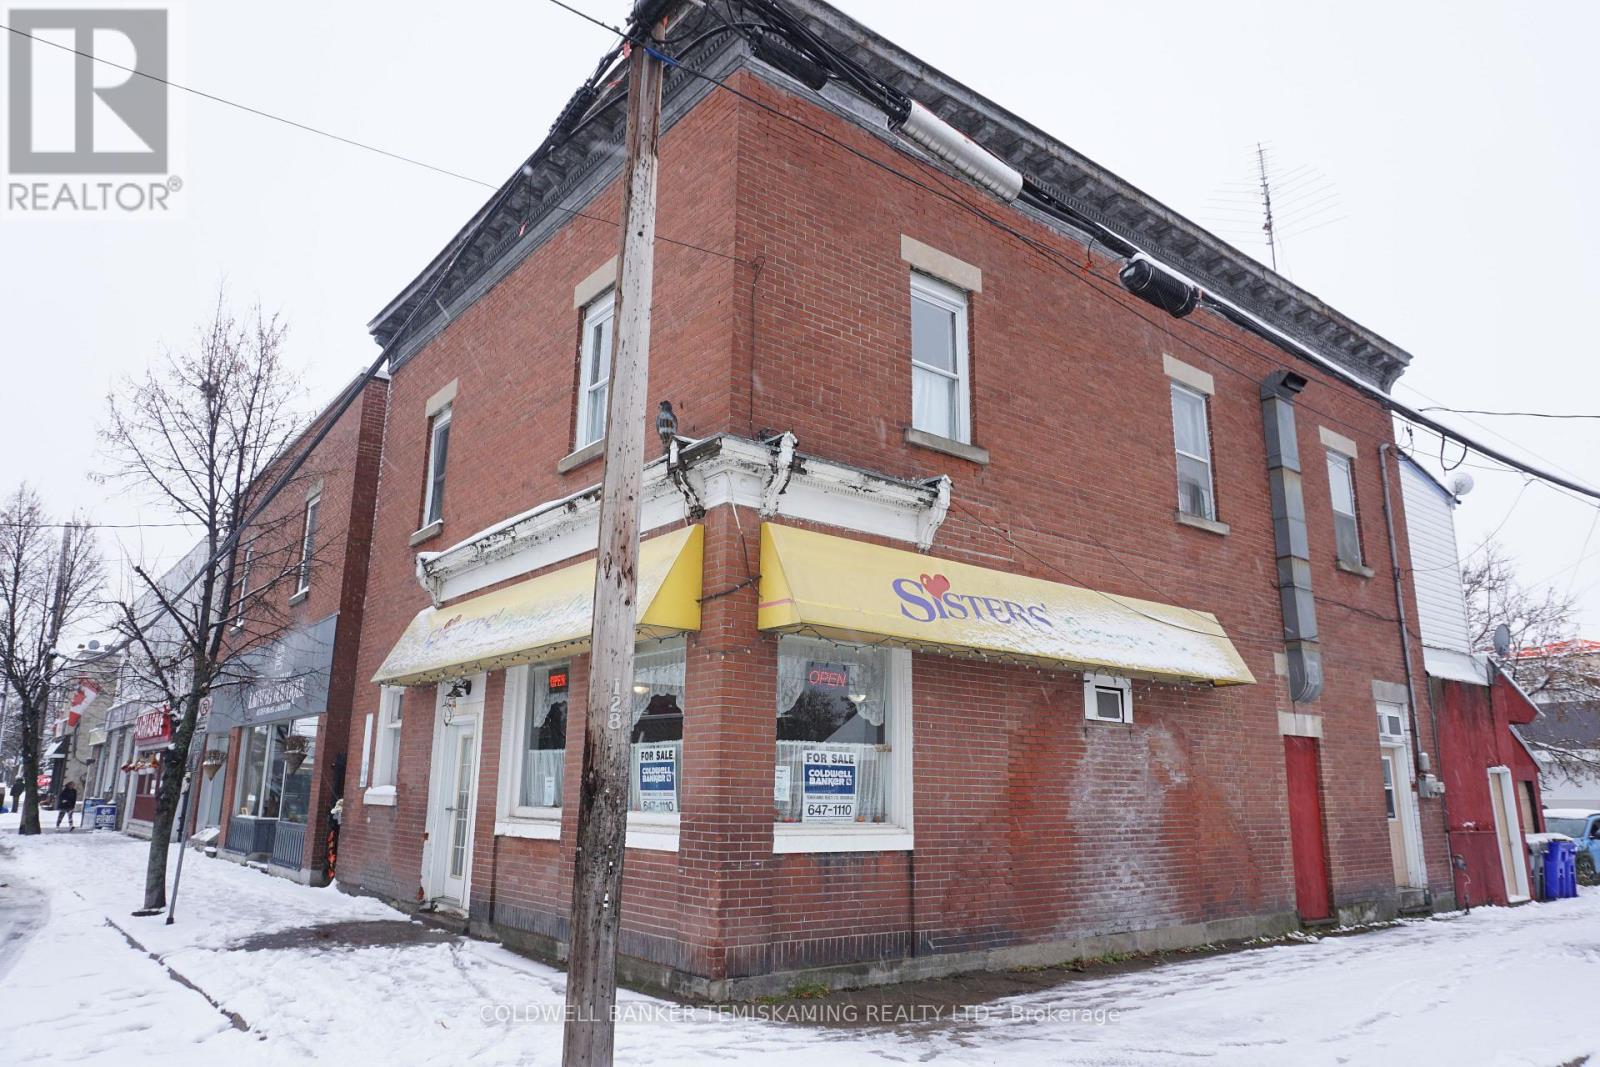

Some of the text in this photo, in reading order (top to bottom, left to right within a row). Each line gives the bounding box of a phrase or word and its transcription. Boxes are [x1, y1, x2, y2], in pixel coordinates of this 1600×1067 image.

[809, 670, 846, 687] OPEN
[641, 750, 673, 761] FOR SALE
[806, 753, 854, 764] FOR SALE
[808, 769, 853, 778] COLDWELL
[809, 777, 845, 787] BANKER
[807, 804, 852, 816] 647-1110
